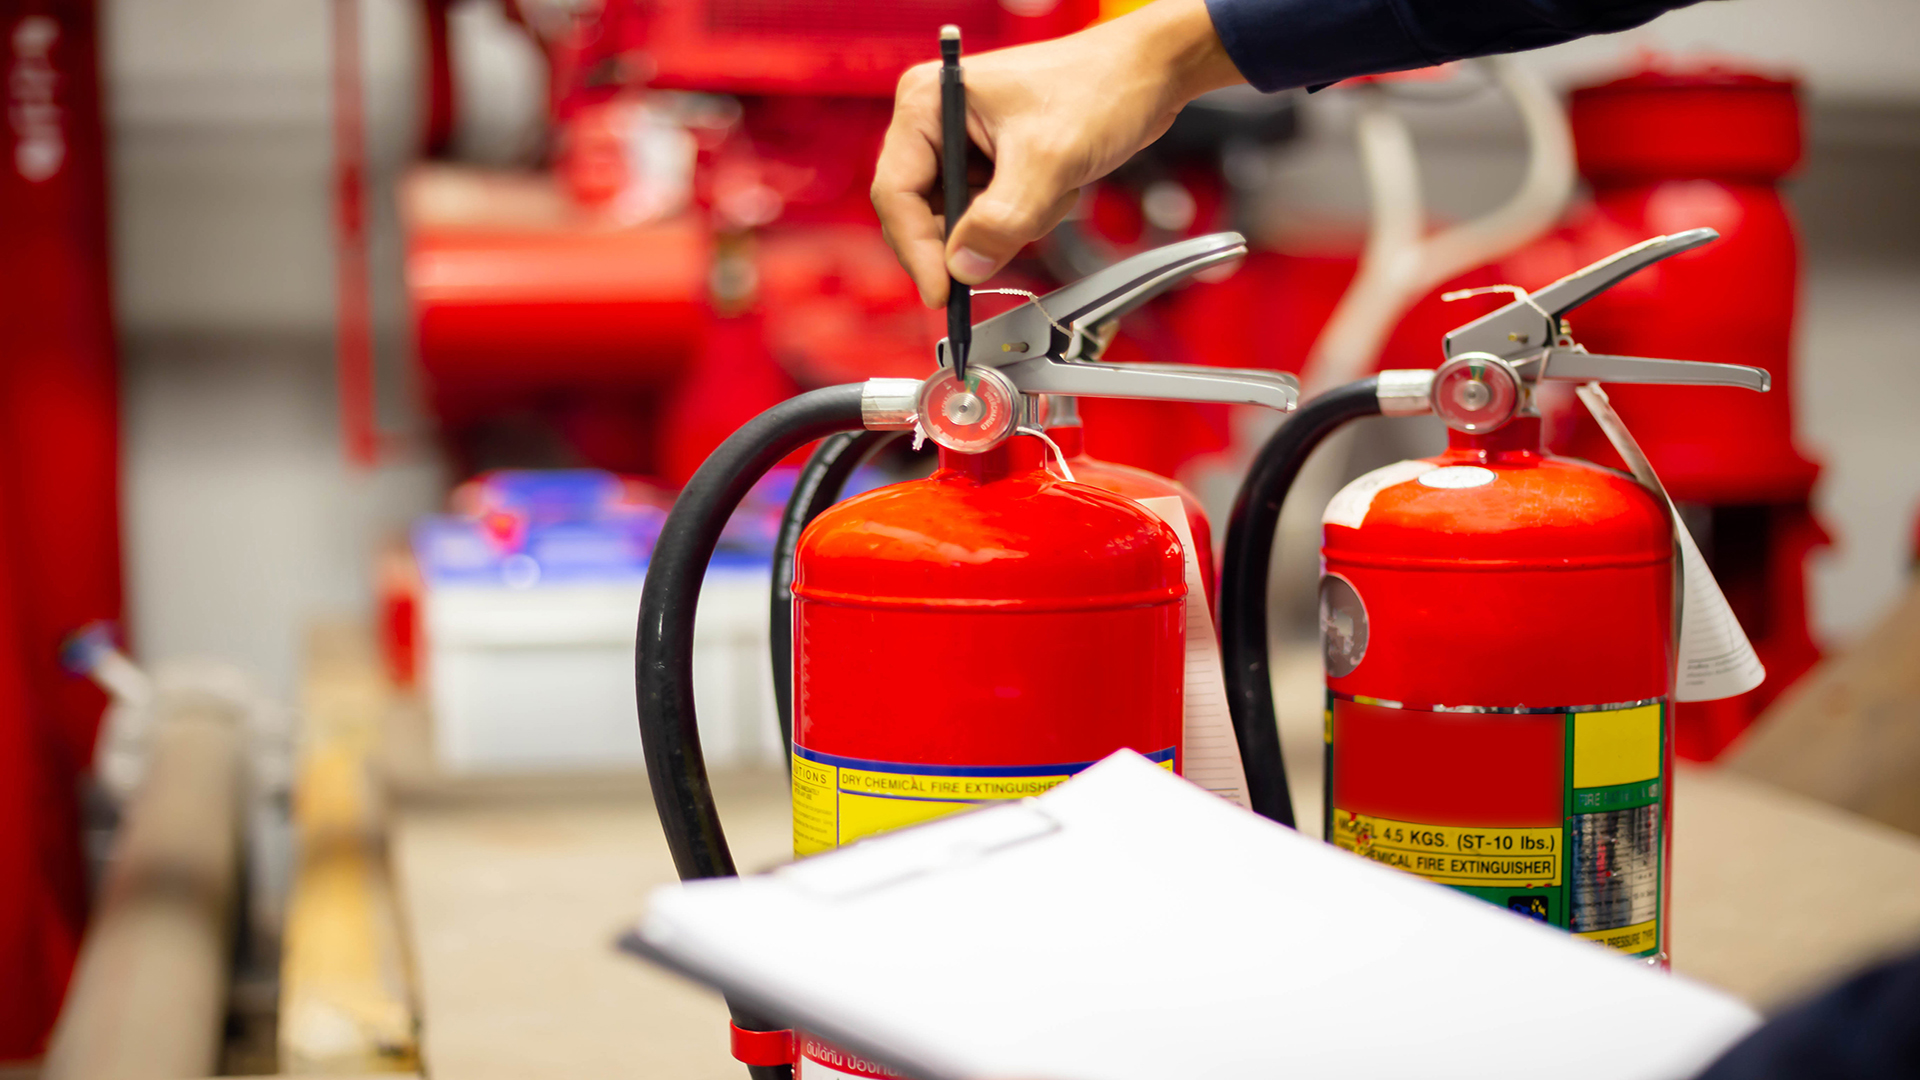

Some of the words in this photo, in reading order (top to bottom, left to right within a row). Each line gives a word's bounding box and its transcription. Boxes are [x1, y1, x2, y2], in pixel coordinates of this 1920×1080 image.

[842, 773, 862, 786] DRY
[864, 776, 927, 791] CHEMICAL
[931, 781, 960, 793] FIRE
[965, 780, 1063, 794] EXTINGUISHE
[1383, 827, 1404, 843] 4.5
[1410, 830, 1449, 848] KGS.
[1457, 833, 1513, 852] (ST-10
[1520, 834, 1555, 853] lbs.)
[1417, 856, 1445, 872] FIRE
[1450, 859, 1552, 875] EXTINGUISHER
